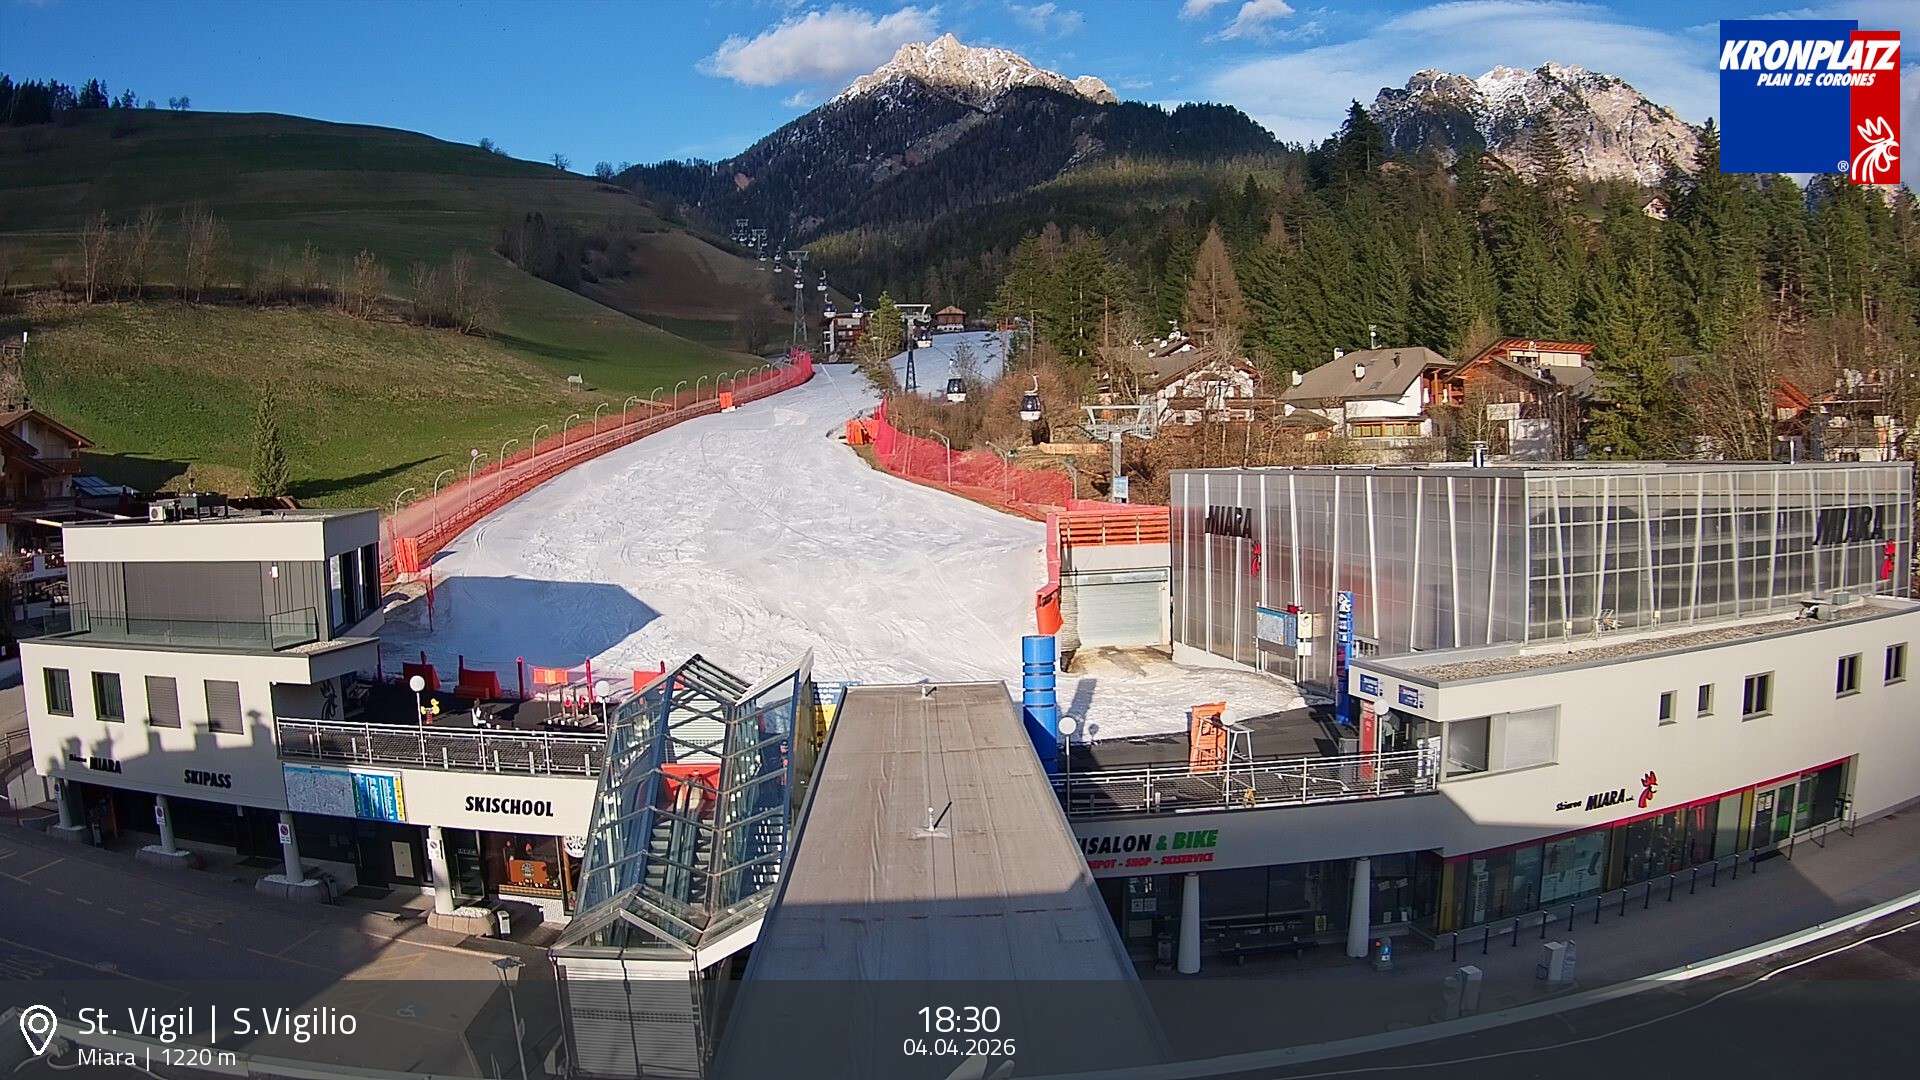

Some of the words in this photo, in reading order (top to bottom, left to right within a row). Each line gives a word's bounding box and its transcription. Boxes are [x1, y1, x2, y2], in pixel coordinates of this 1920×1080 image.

[1205, 505, 1253, 539] MIARA
[1812, 506, 1884, 546] MIARA
[90, 756, 122, 774] MIARA
[184, 769, 232, 789] SKIPASS
[465, 796, 554, 817] SKISCHOOL
[1585, 788, 1625, 812] MIARA
[1156, 835, 1168, 851] &
[1172, 829, 1219, 850] BIKE
[1125, 856, 1153, 868] SHOP
